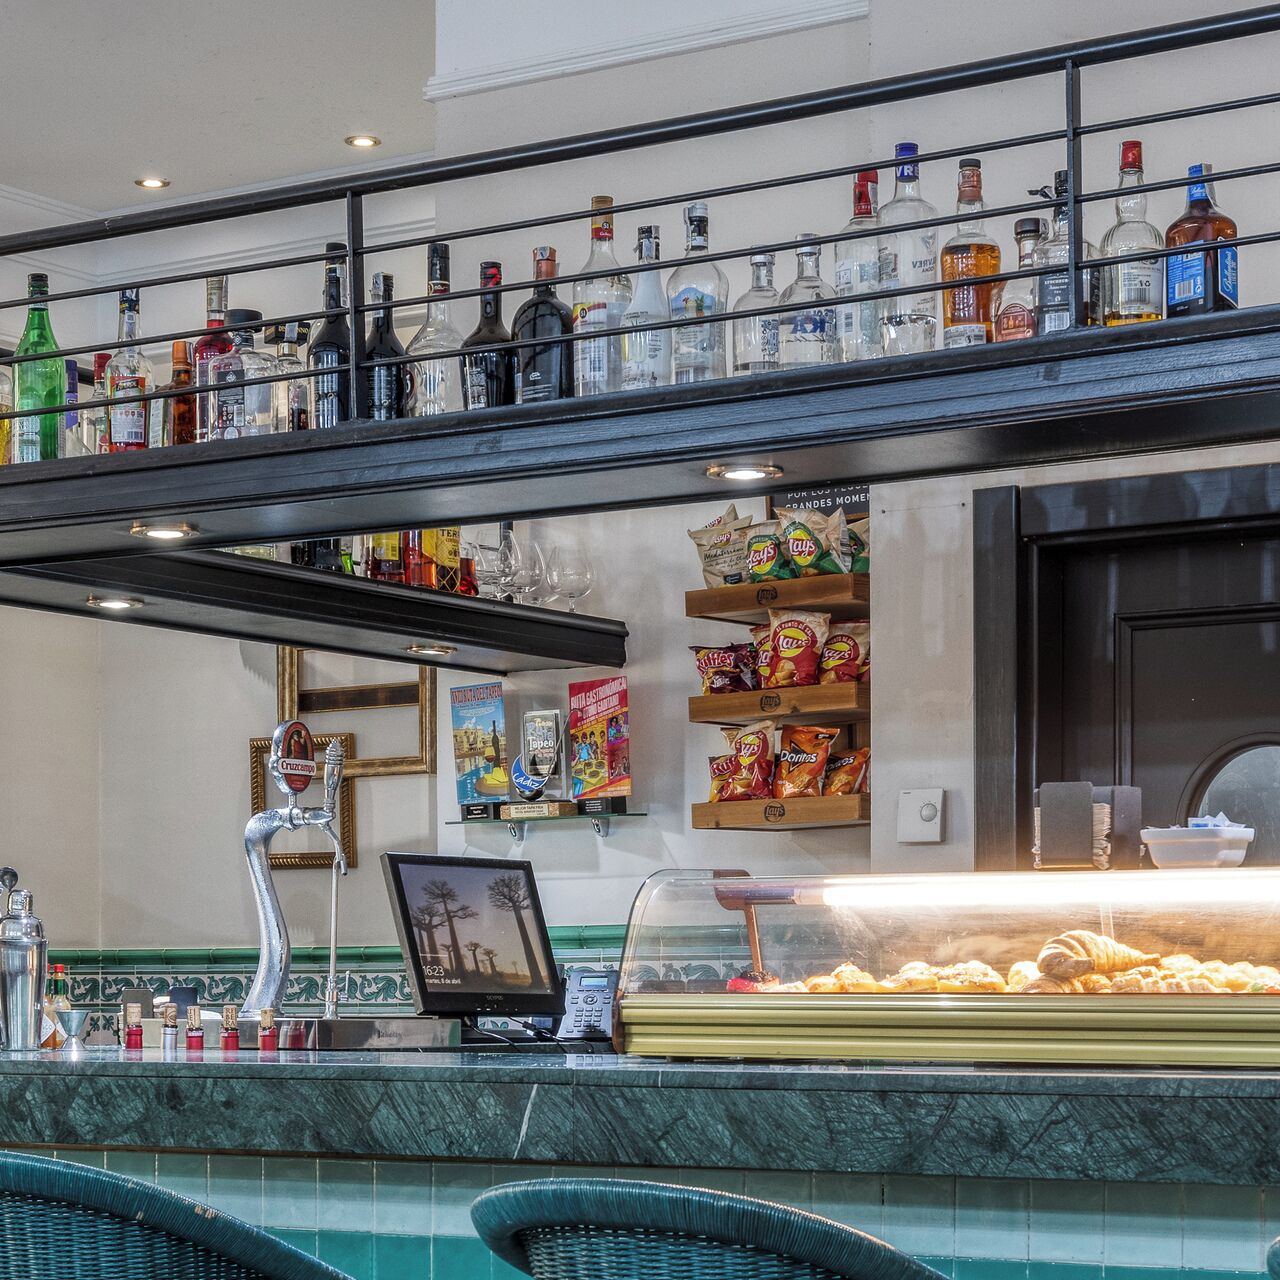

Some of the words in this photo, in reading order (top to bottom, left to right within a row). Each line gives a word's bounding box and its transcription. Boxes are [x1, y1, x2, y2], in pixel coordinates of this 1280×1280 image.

[527, 736, 554, 751] Tapeo
[780, 750, 818, 764] Doritos
[281, 760, 315, 774] Cruzcampo
[512, 772, 541, 790] Cádiz
[422, 965, 445, 977] 16:23
